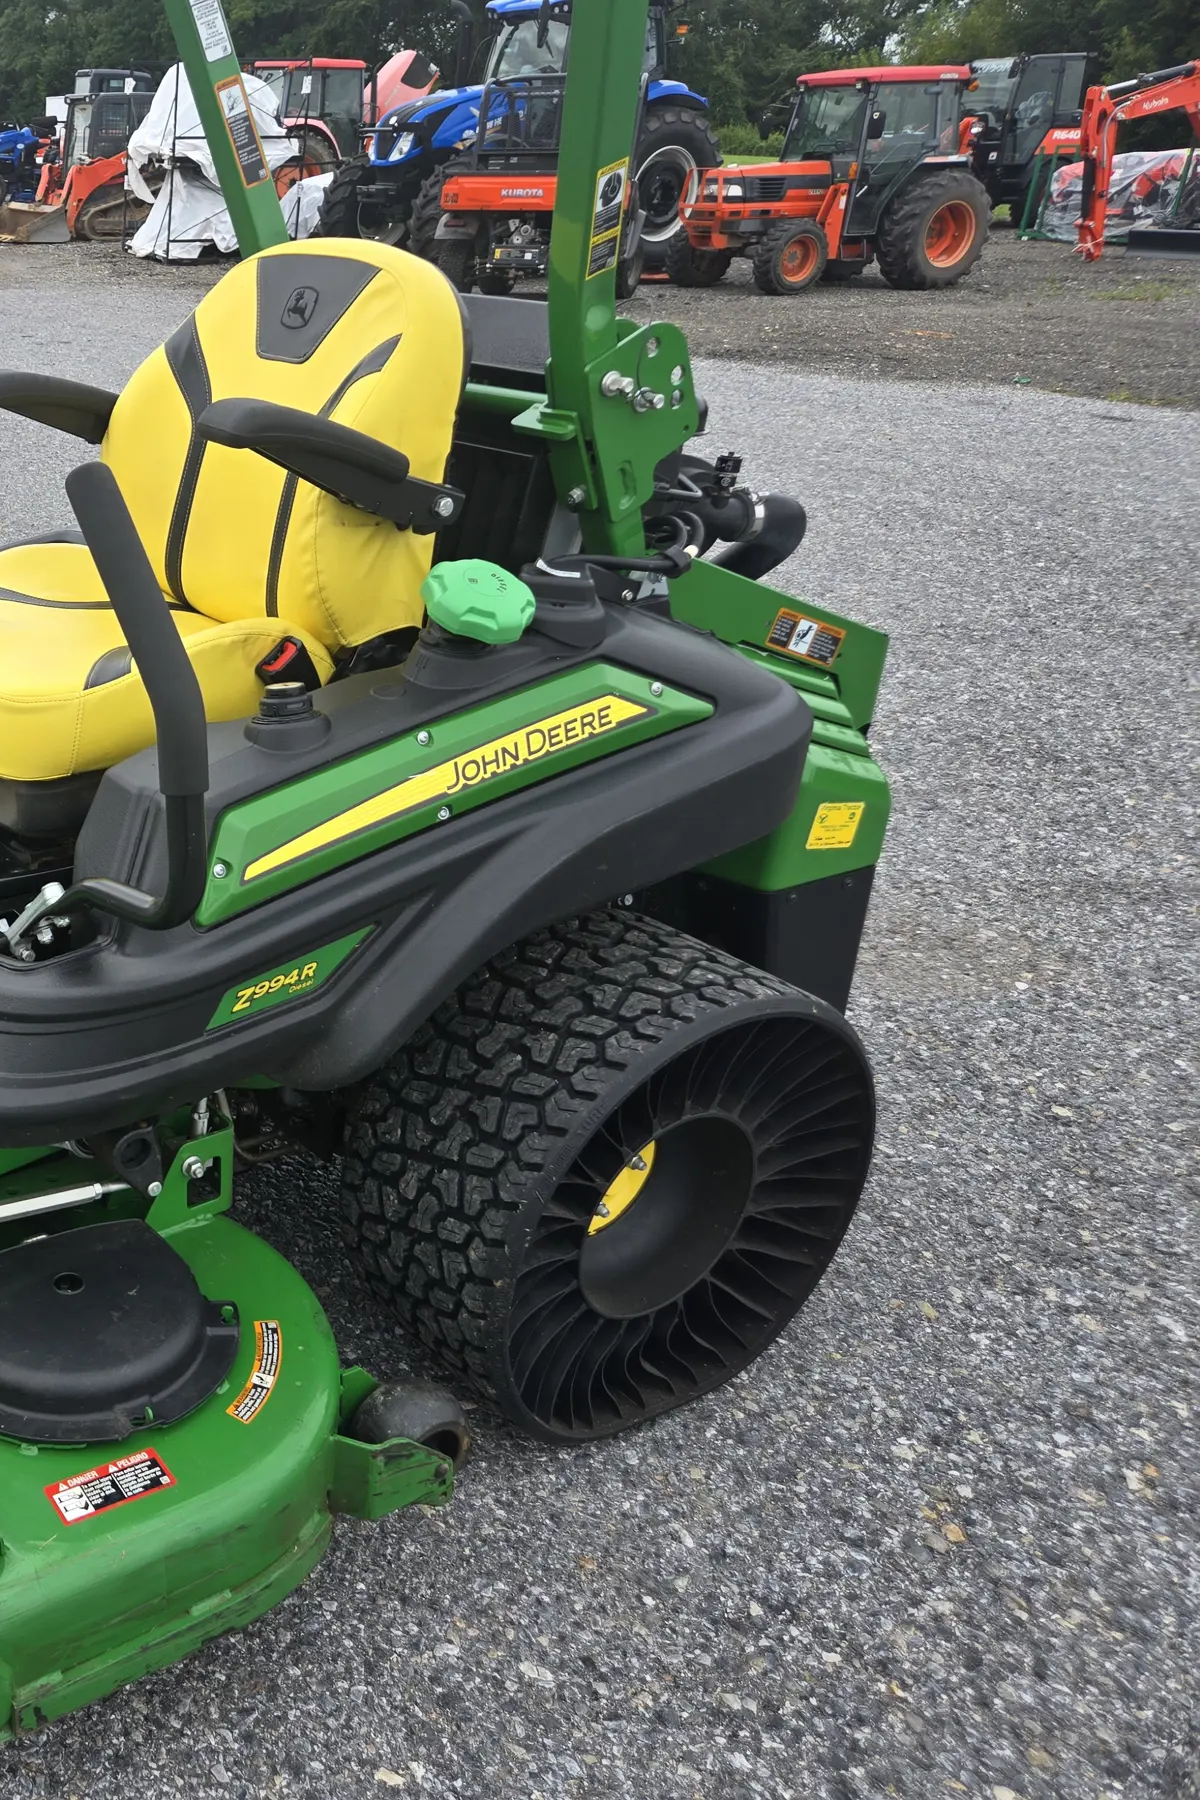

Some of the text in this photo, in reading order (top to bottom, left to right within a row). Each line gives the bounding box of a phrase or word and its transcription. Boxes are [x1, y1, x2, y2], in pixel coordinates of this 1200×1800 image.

[501, 189, 543, 197] KUBOTA
[447, 705, 613, 791] JOHN DEERE
[288, 978, 314, 994] Diesel
[116, 1452, 149, 1469] PELIGRO
[67, 1471, 99, 1487] DANGER
